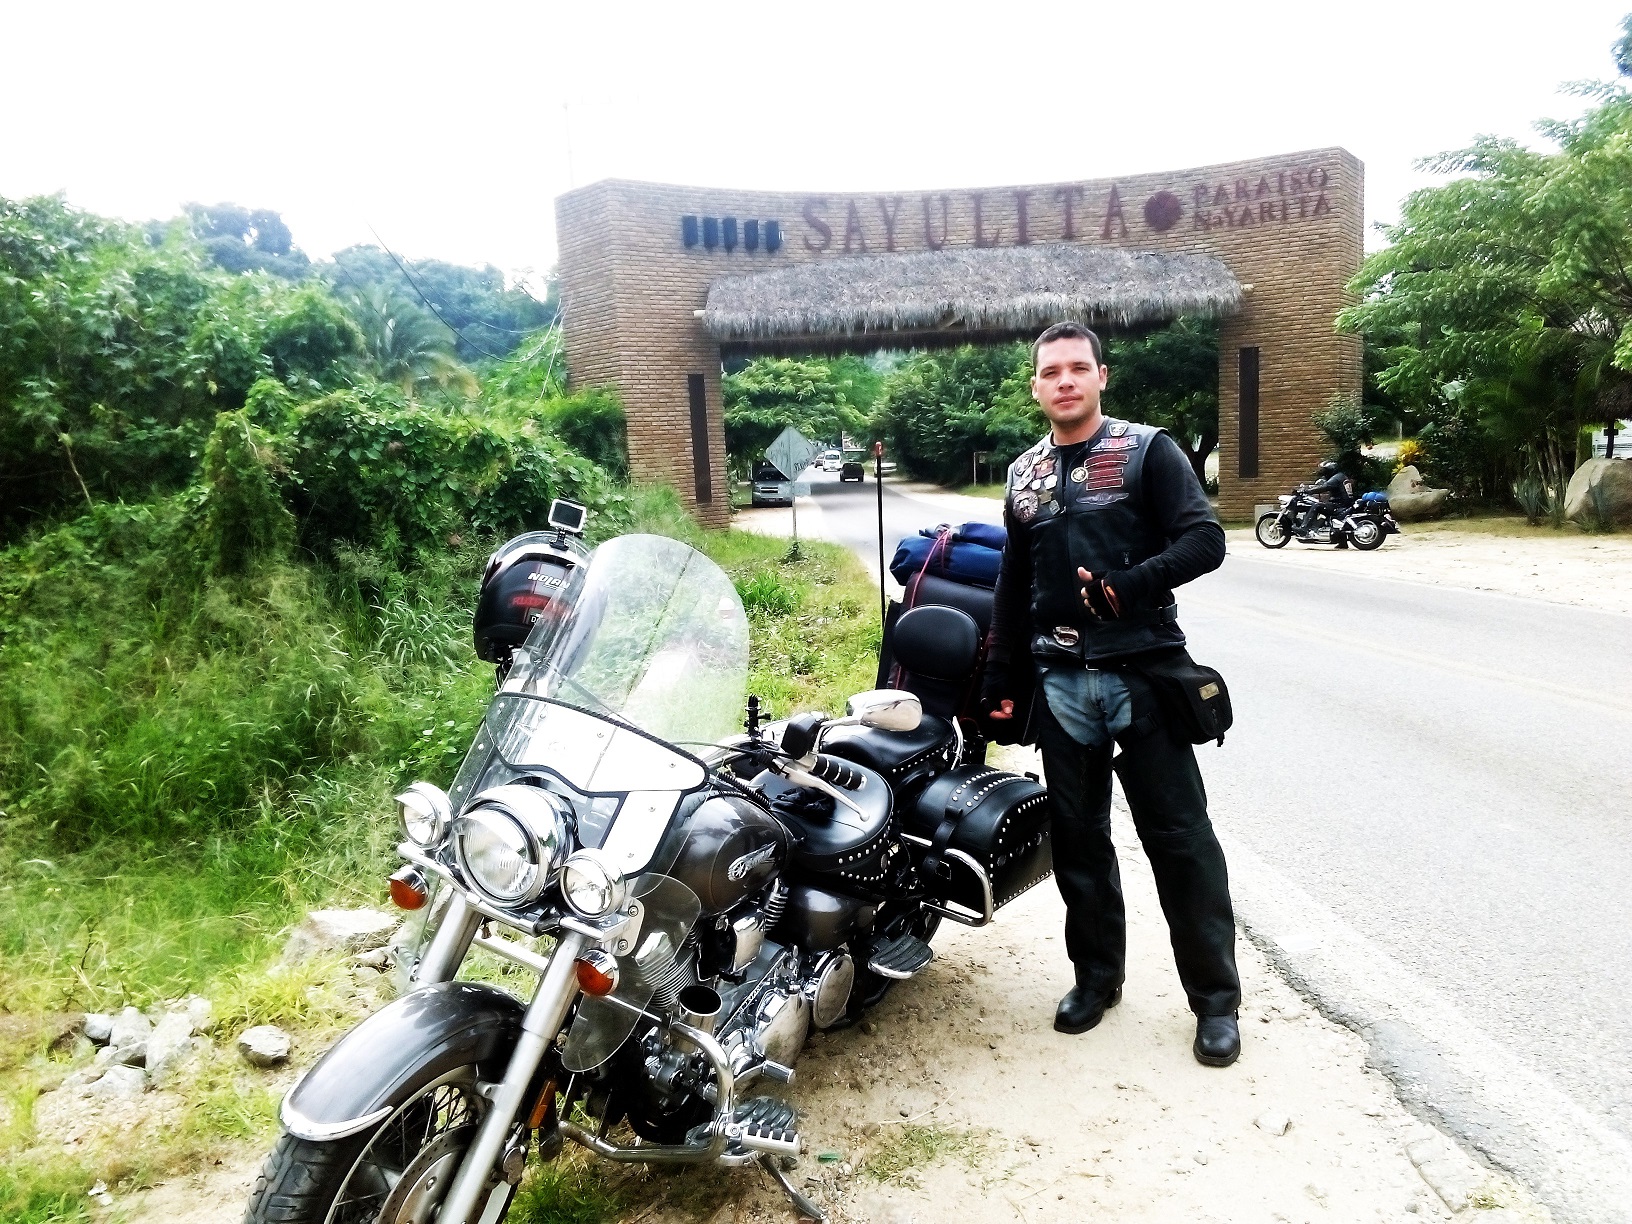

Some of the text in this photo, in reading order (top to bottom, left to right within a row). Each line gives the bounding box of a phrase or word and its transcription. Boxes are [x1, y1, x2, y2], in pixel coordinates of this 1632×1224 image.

[1193, 166, 1330, 207] PARAISO
[802, 182, 1130, 252] SAYULITA
[527, 572, 570, 589] NOLAN
